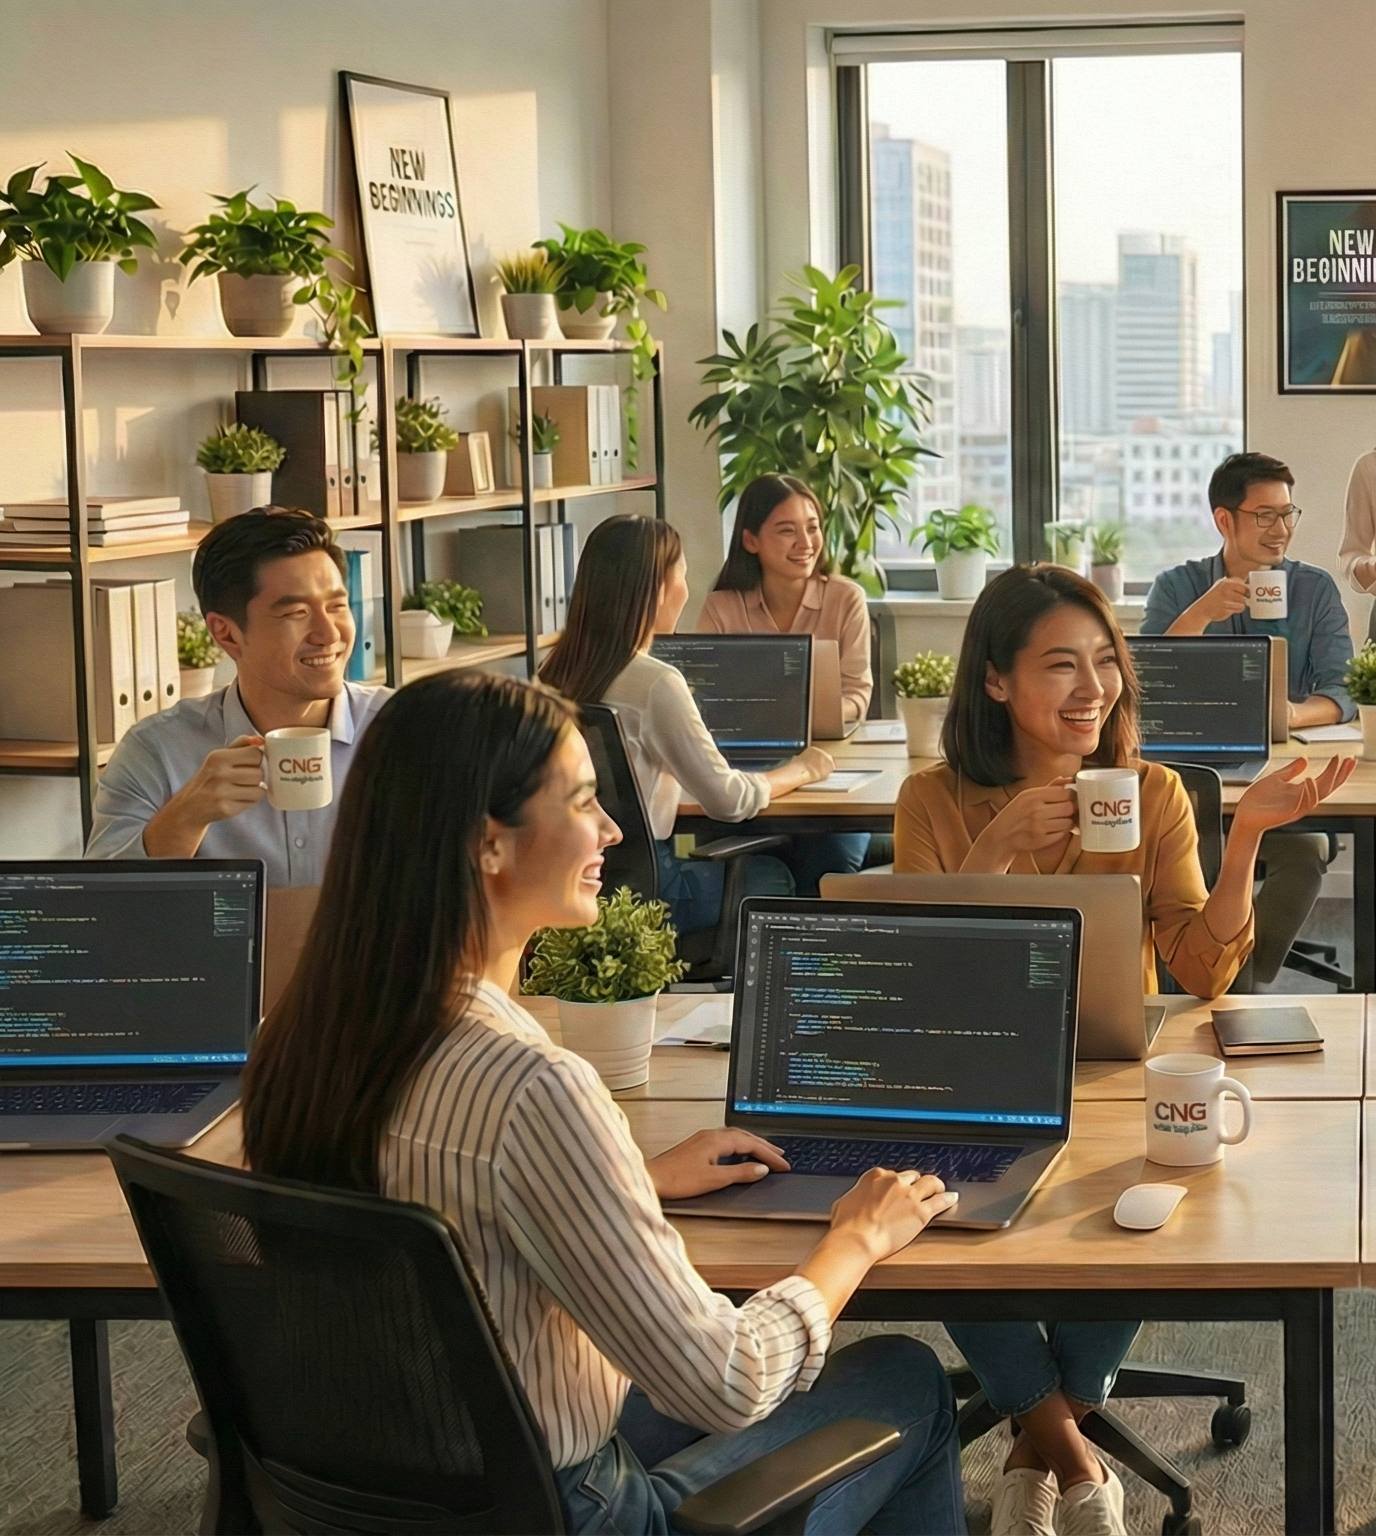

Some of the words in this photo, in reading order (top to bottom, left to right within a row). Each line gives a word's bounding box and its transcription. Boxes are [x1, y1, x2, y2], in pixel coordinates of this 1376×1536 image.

[389, 147, 426, 181] NEW
[369, 181, 455, 219] BEGINNINGS
[1329, 229, 1375, 255] NEW
[279, 757, 323, 774] CNG
[1090, 799, 1131, 817] CNG
[1154, 1101, 1207, 1122] CNG
